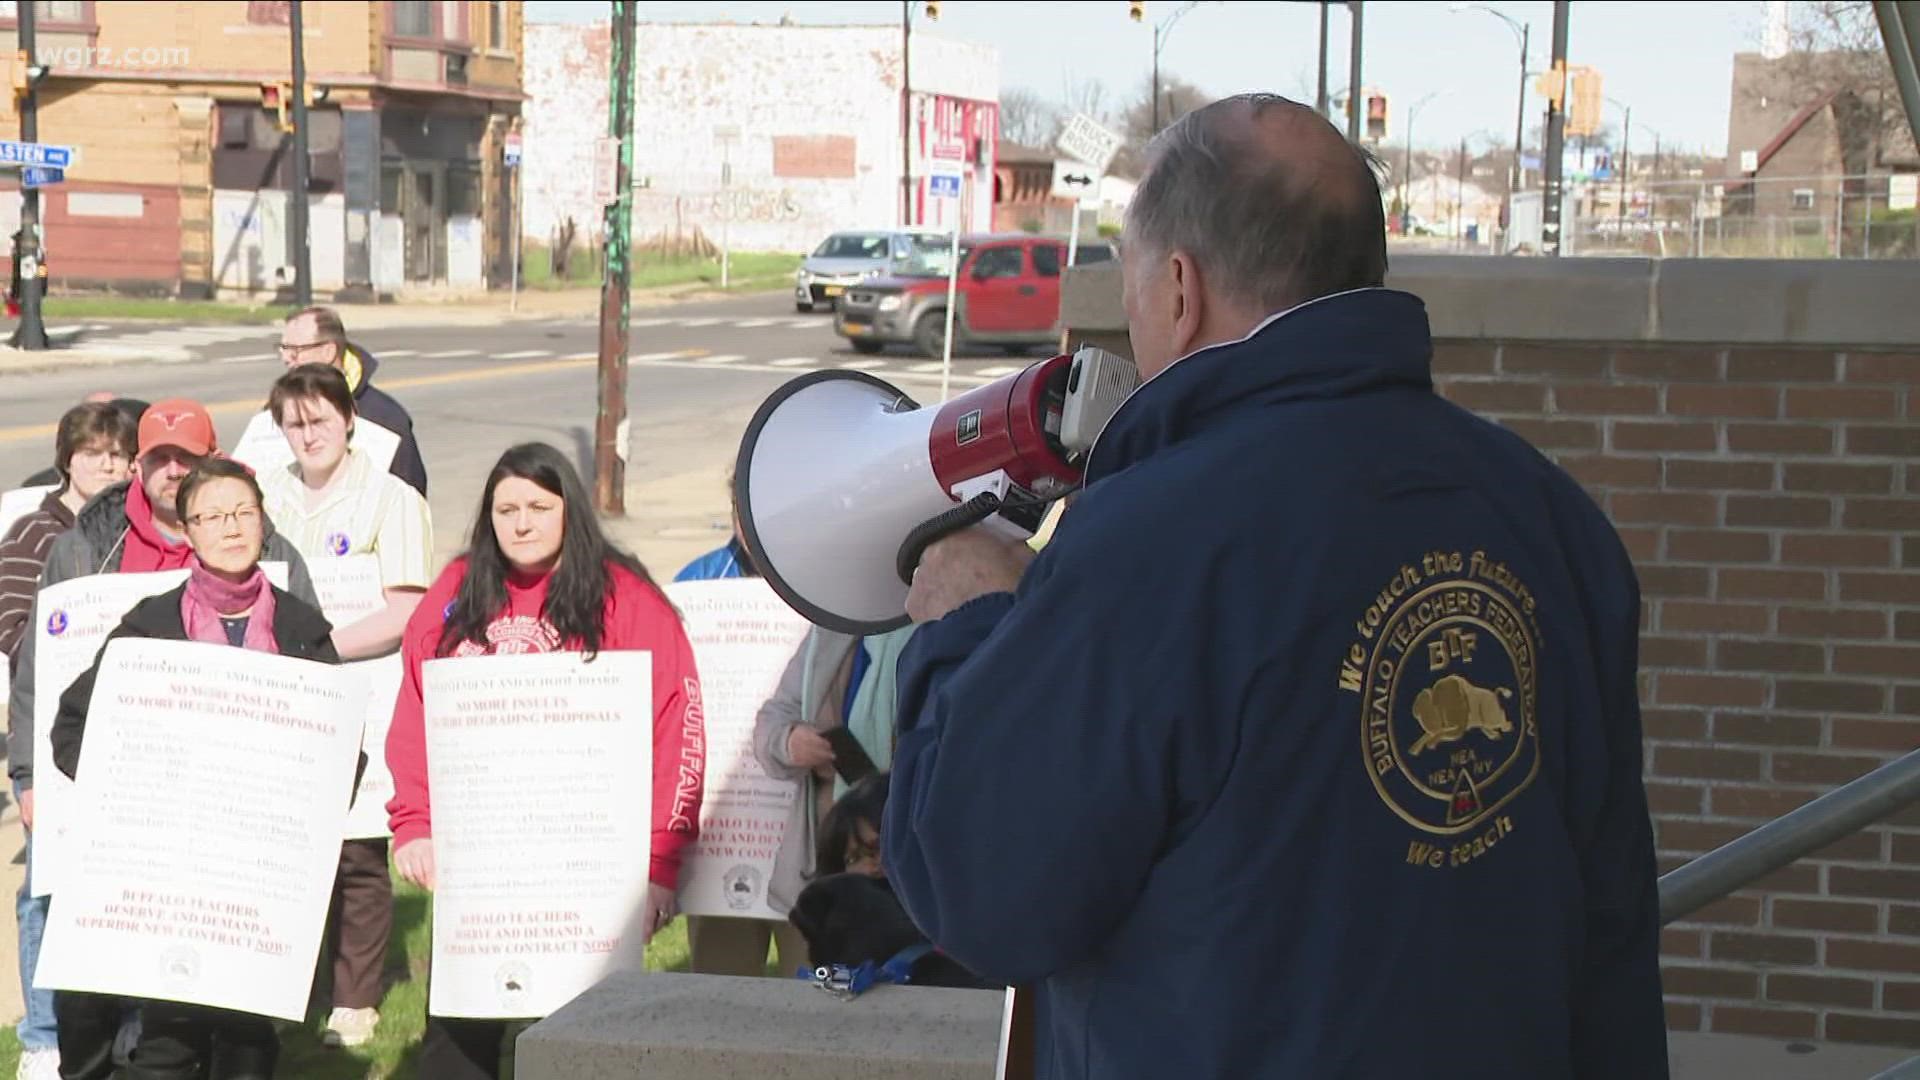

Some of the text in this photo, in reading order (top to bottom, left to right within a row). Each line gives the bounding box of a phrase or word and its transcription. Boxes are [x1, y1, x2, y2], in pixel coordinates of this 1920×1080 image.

[1062, 129, 1106, 163] ROUTE
[1072, 115, 1114, 150] TRUCK
[1338, 643, 1367, 693] We
[1356, 564, 1421, 639] touch
[1423, 551, 1463, 576] the
[1428, 627, 1477, 671] BTF
[170, 683, 290, 711] NO MORE INSULTS
[1370, 659, 1395, 775] BUFFALO
[1387, 591, 1481, 653] TEACHERS
[117, 694, 336, 734] NO MORE DEGRADING PROPOSALS
[473, 699, 507, 711] MORE
[512, 697, 568, 709] INSULTS
[466, 713, 539, 728] DEGRADING
[543, 711, 621, 724] PROPOSALS
[1451, 749, 1476, 765] NEA
[1429, 760, 1493, 785] NEA NY
[707, 847, 733, 857] NEW
[732, 834, 756, 844] AND
[1406, 816, 1513, 868] We teach
[122, 889, 260, 917] BUFFALO TEACHERS
[104, 903, 271, 936] DESERVE AND DEMAND A
[495, 928, 520, 939] AND
[524, 926, 583, 939] DEMAND
[586, 925, 595, 936] A
[510, 911, 580, 925] TEACHERS
[75, 917, 140, 932] SUPERIOR
[144, 923, 173, 936] NEW
[178, 926, 252, 948] CONTRACT
[505, 940, 577, 954] CONTRACT
